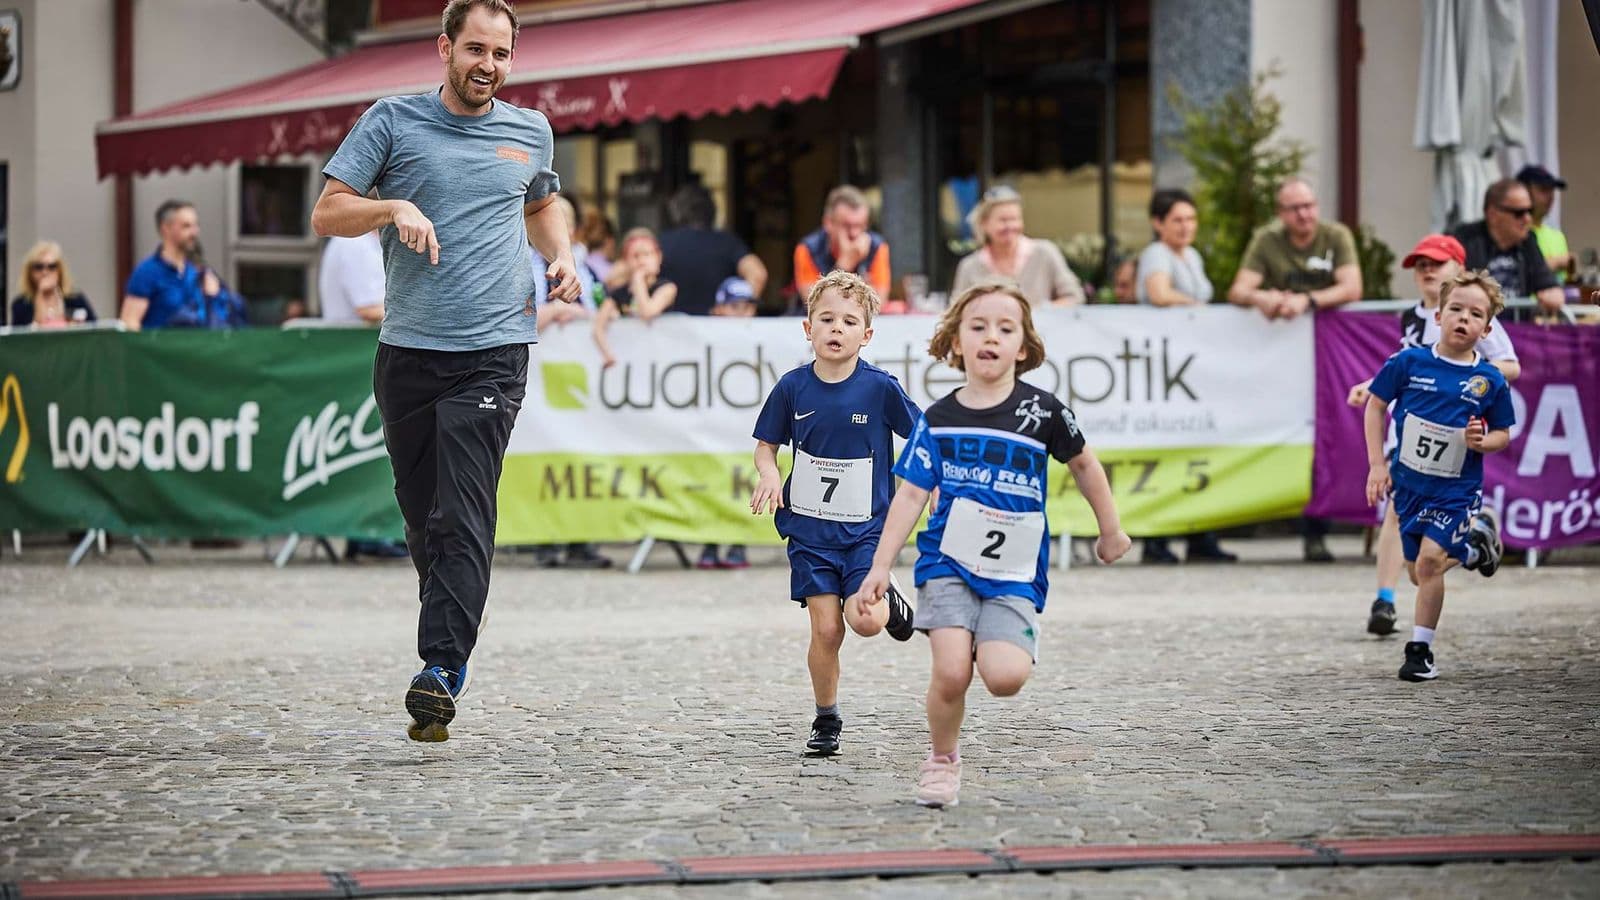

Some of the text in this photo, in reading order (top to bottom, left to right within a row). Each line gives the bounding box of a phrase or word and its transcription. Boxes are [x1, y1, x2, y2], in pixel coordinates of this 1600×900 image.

[851, 413, 869, 425] FELIX
[48, 401, 260, 472] Loosdorf
[282, 394, 388, 496] McC
[1415, 435, 1449, 463] 57
[815, 460, 854, 469] INTERSPORT
[540, 462, 667, 502] MELK
[1182, 458, 1212, 493] 5
[821, 476, 840, 503] 7
[980, 530, 1007, 560] 2
